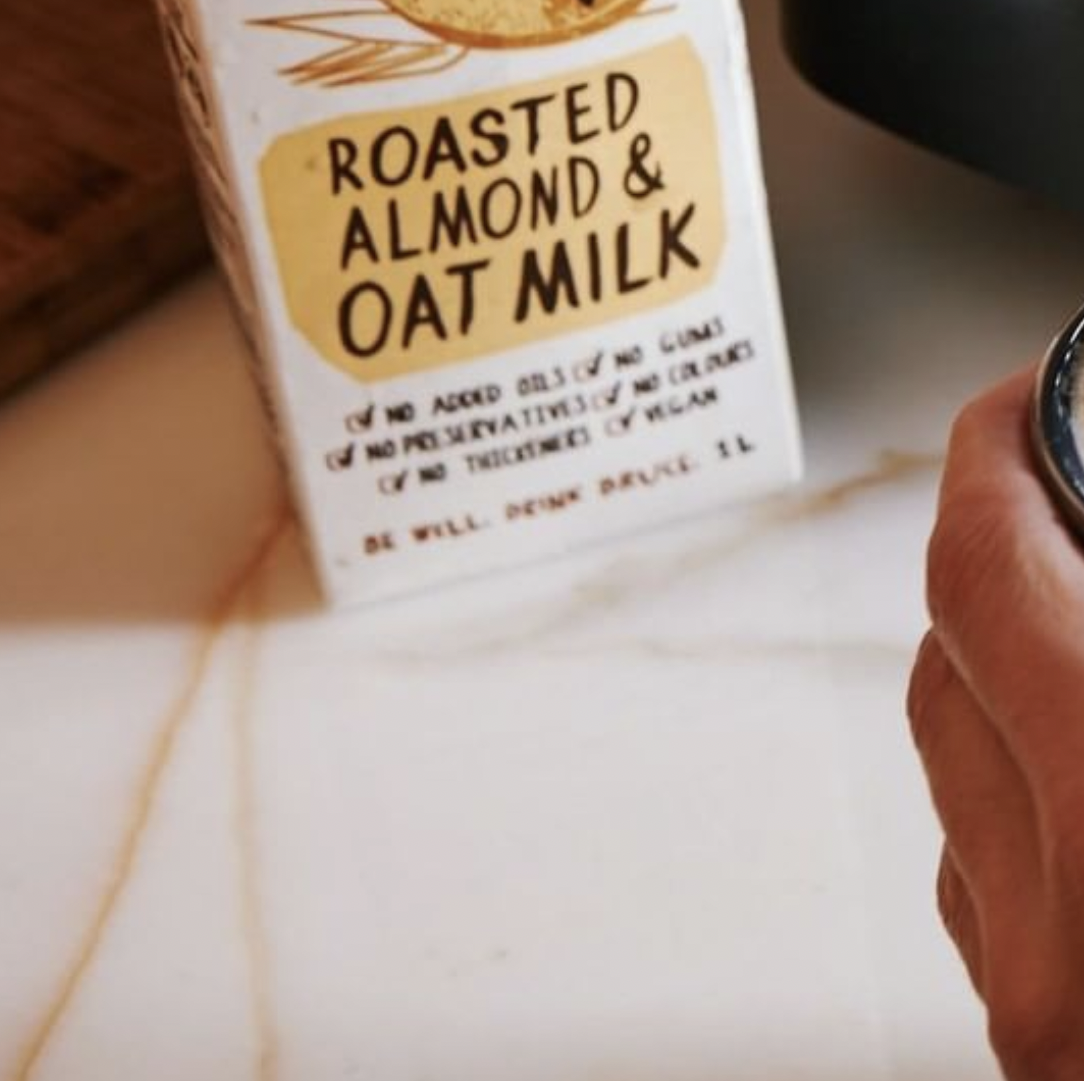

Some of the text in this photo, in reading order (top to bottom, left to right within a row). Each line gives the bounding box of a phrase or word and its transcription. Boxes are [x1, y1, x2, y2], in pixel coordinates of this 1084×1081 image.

[328, 72, 639, 196] ROASTED
[340, 132, 666, 271] ALMOND &
[338, 203, 700, 358] OAT MILK
[366, 340, 755, 462] NO PRESERVATIVES NO COLOURS
[386, 403, 415, 425] NO
[433, 384, 502, 415] ADDED
[517, 367, 566, 396] OILS
[615, 346, 643, 369] NO
[419, 387, 720, 486] NO THICKENERS VEGAN
[364, 532, 394, 556] BE
